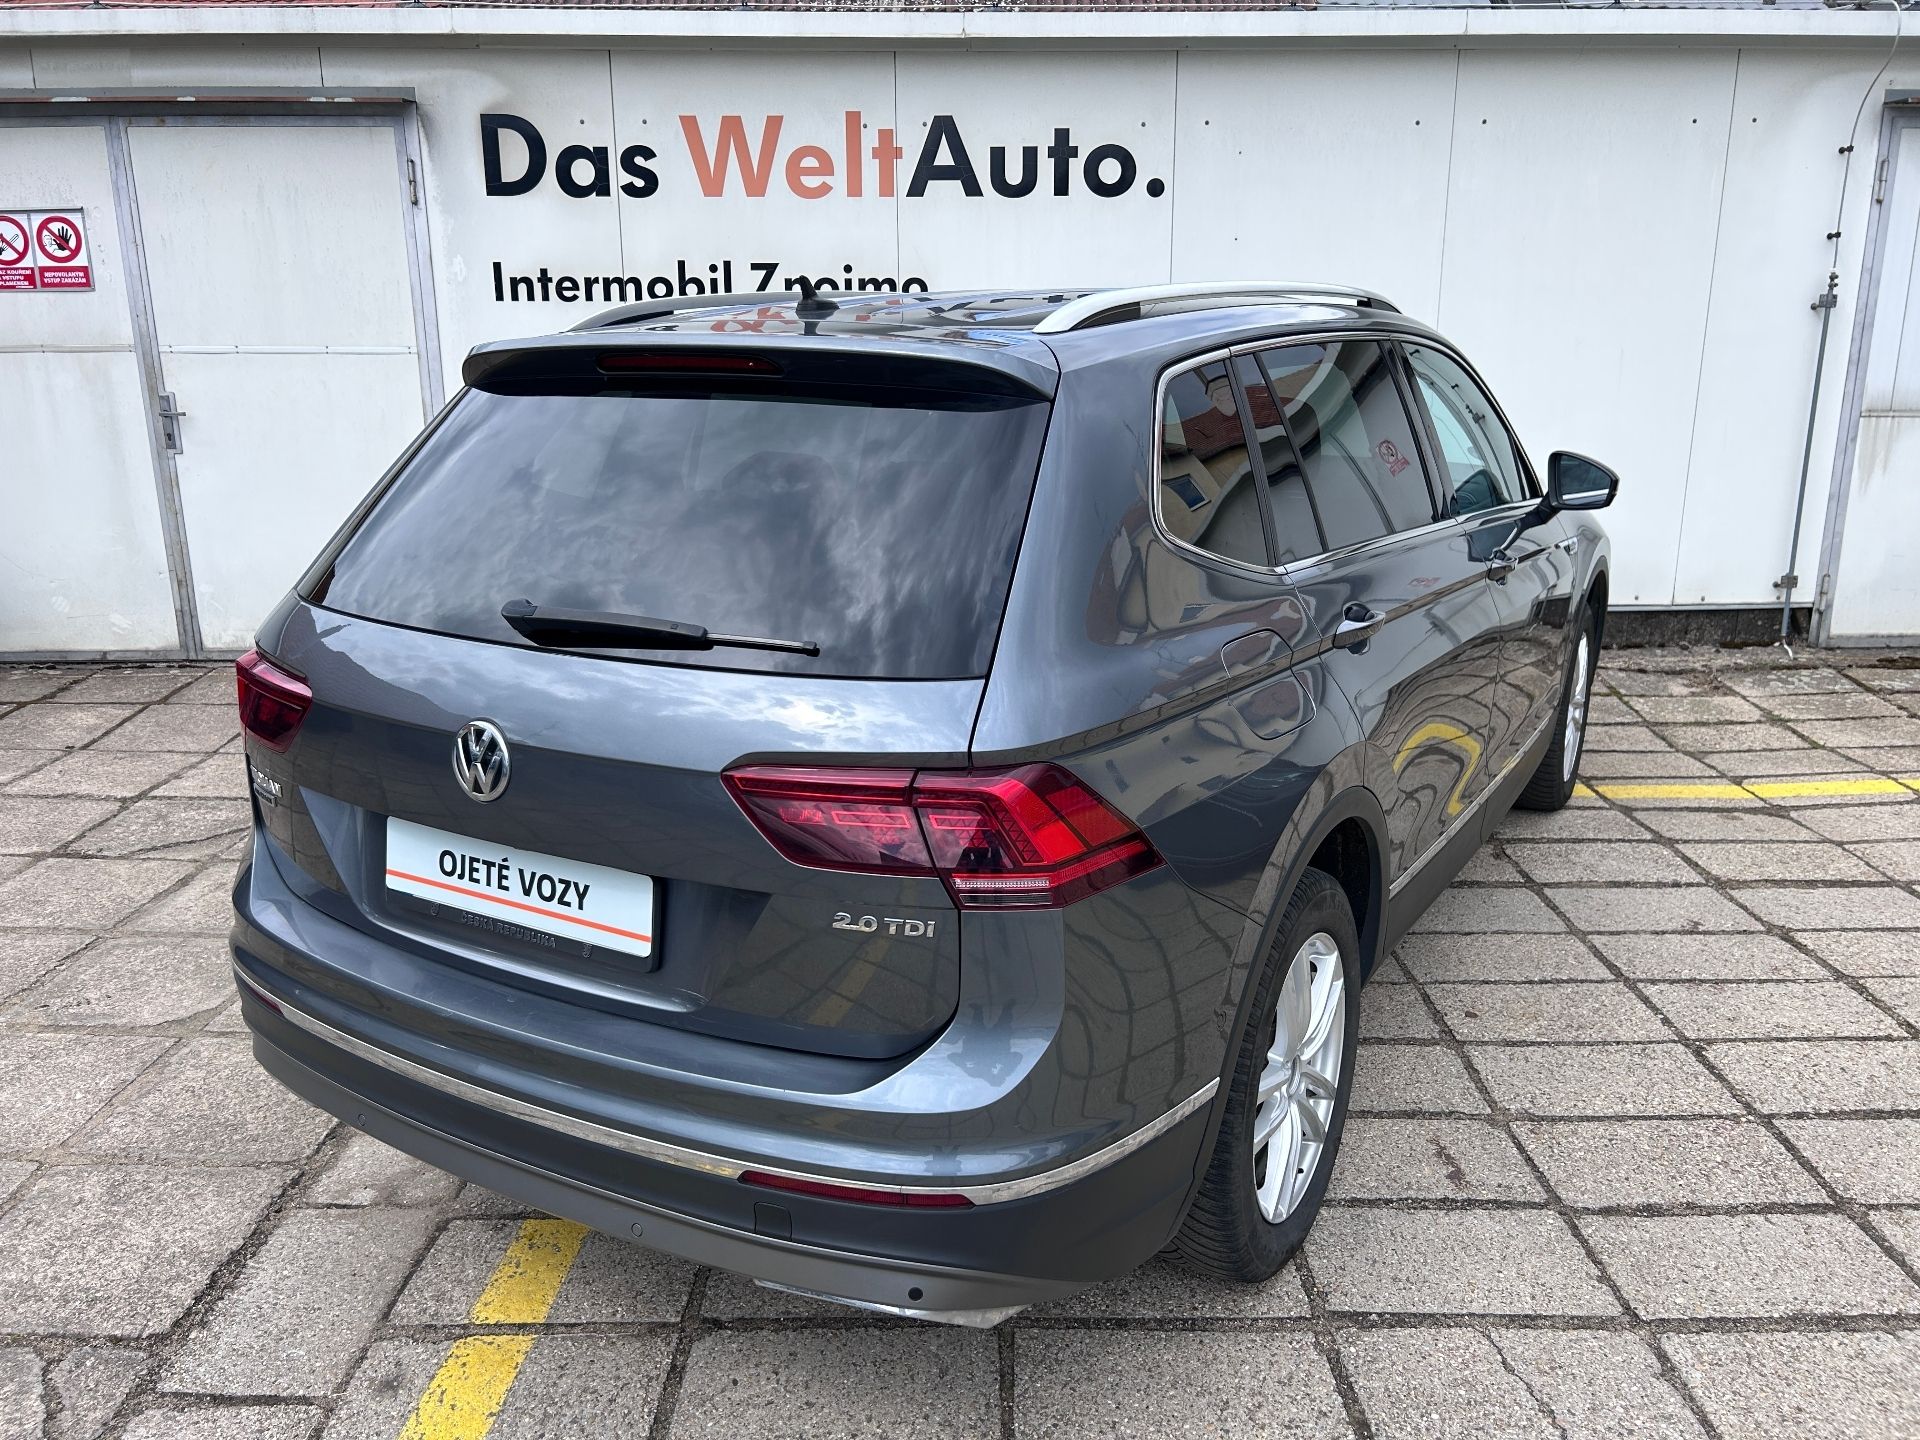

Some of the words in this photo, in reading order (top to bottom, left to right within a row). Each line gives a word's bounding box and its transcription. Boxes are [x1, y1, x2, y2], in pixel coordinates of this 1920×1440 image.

[479, 113, 660, 199] Das
[492, 259, 733, 303] Intermobil
[438, 849, 511, 892] OJETÉ
[518, 867, 590, 911] VOZY
[495, 922, 556, 949] REPUBLIKA
[883, 917, 936, 938] TDI
